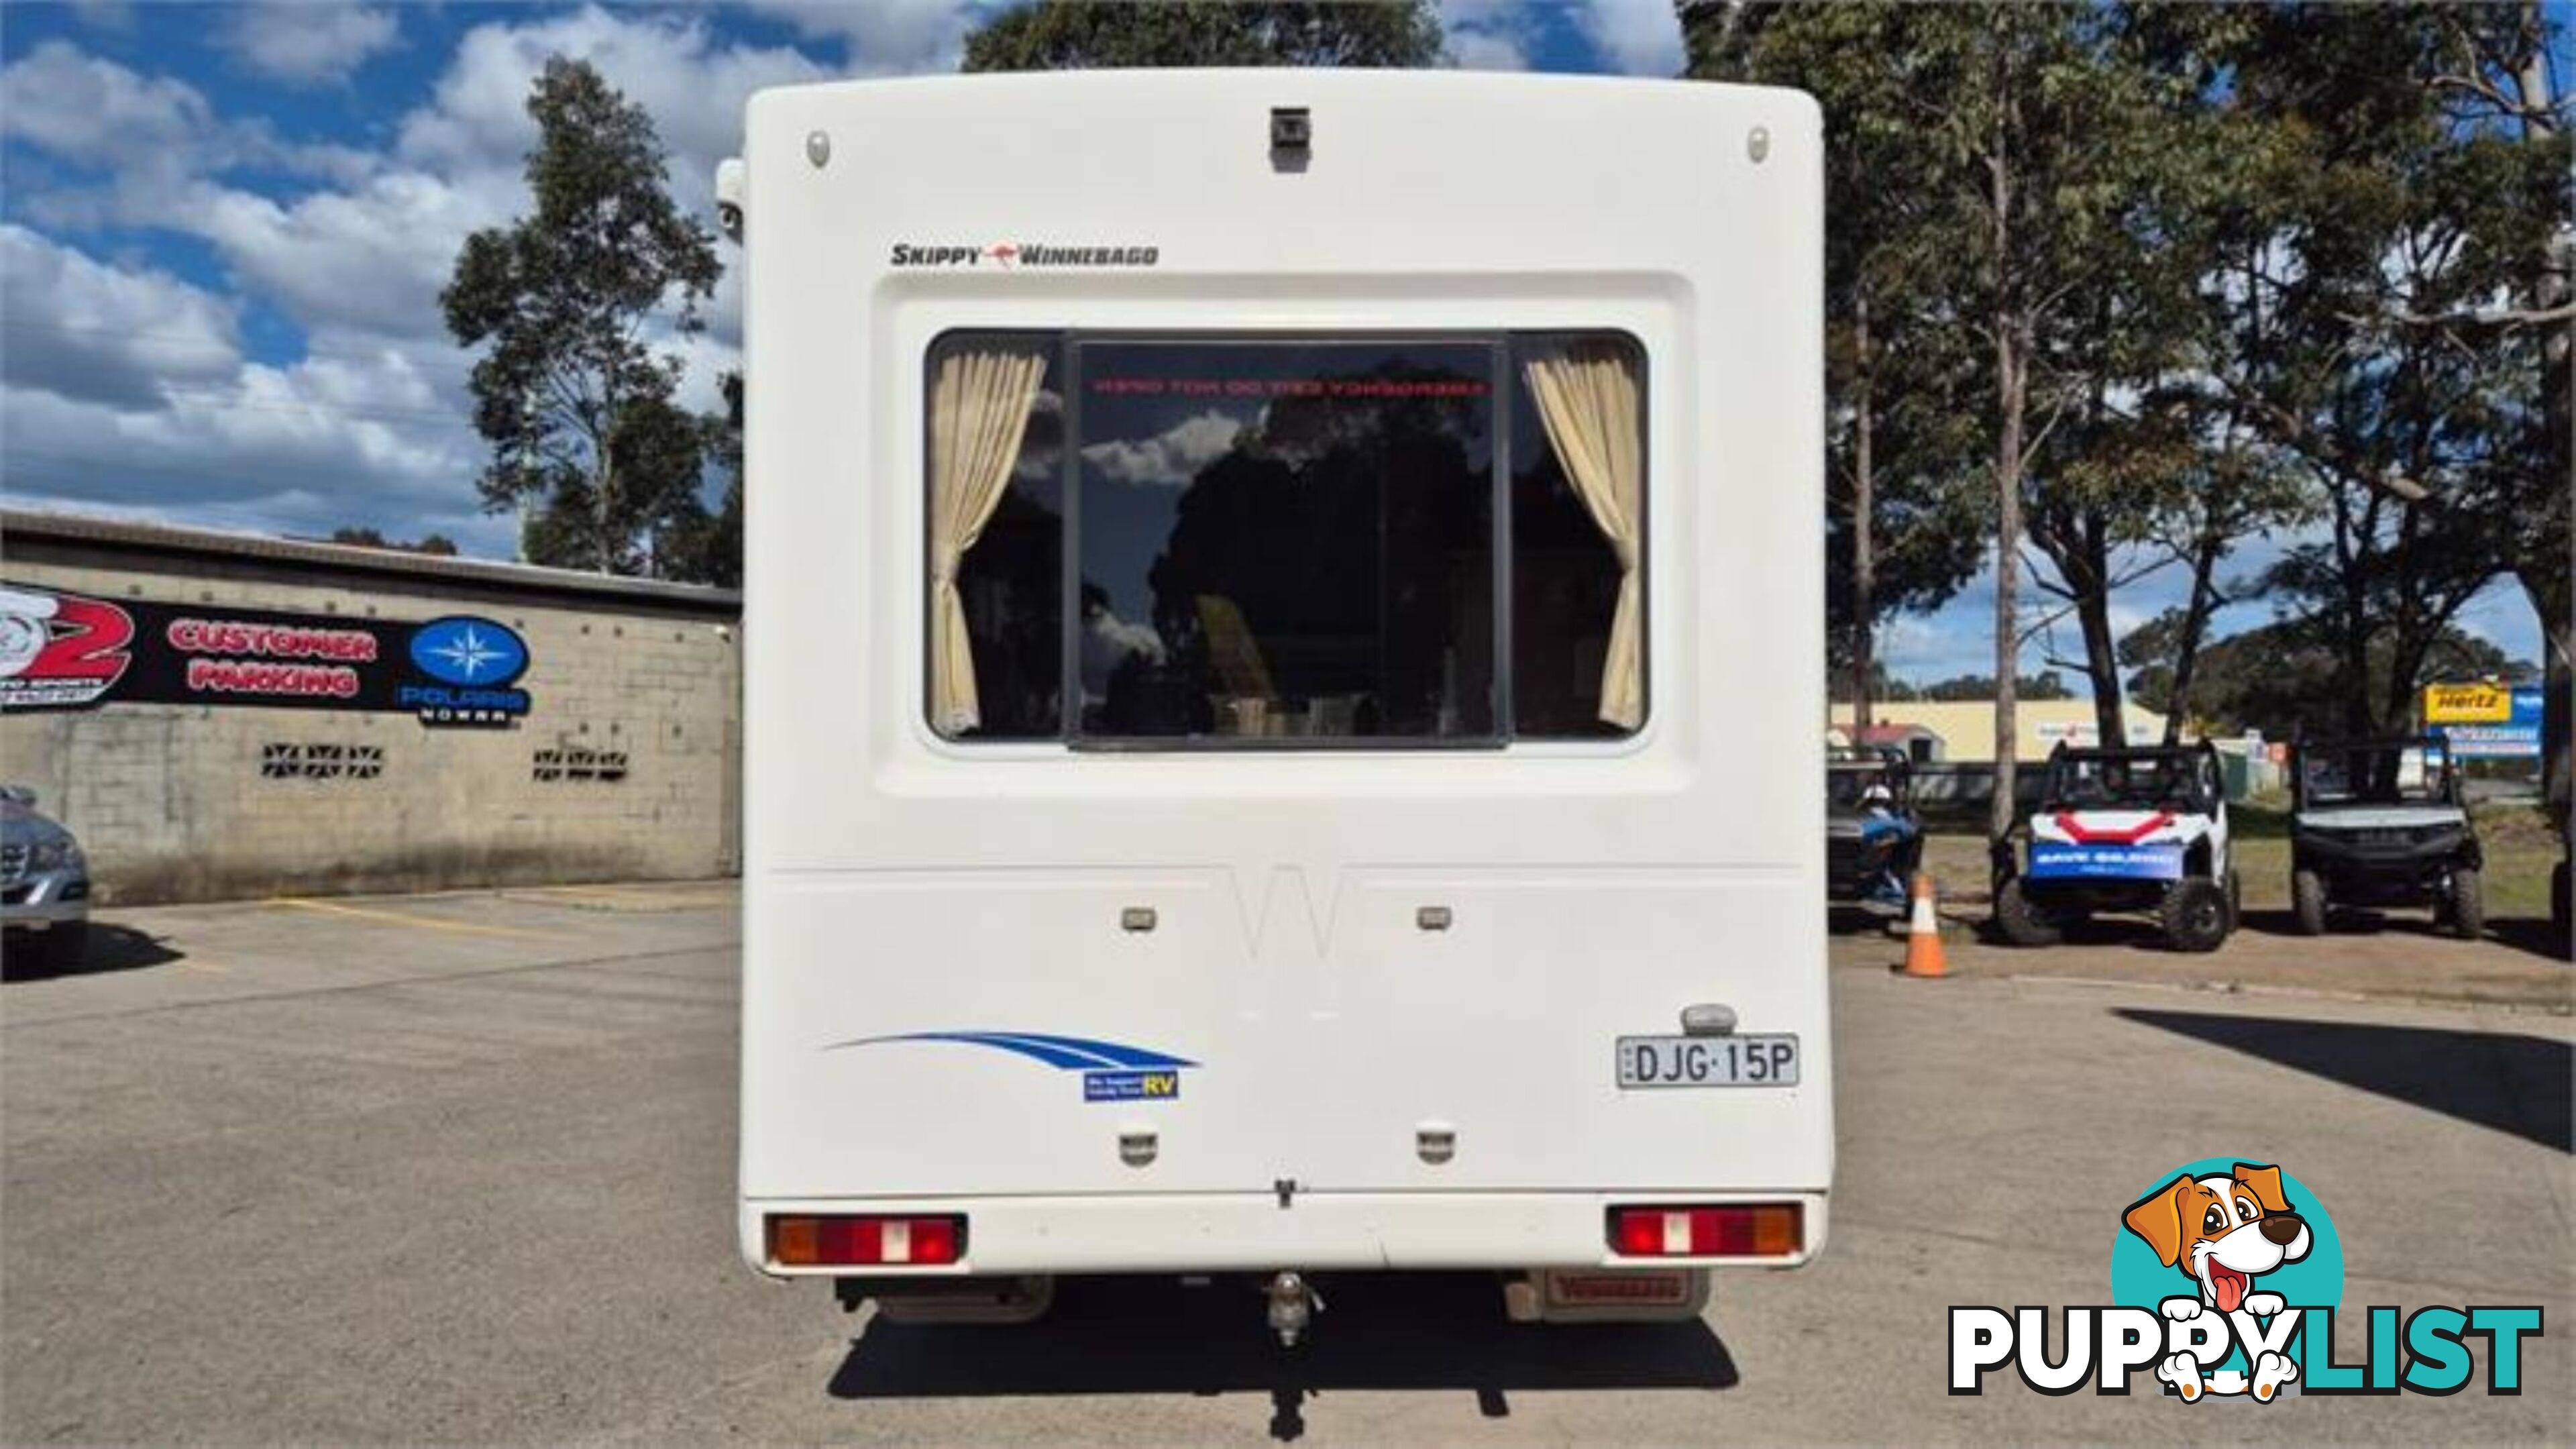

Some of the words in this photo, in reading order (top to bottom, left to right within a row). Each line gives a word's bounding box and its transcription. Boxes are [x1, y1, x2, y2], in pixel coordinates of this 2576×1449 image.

[892, 244, 981, 266] SKIPPY
[1020, 244, 1159, 266] WINNEBAGO
[168, 619, 376, 661] CUSTOMER
[189, 659, 359, 698] PARKING
[401, 687, 526, 709] POLARIS
[2438, 693, 2498, 708] Hertz
[1144, 1075, 1175, 1095] RV
